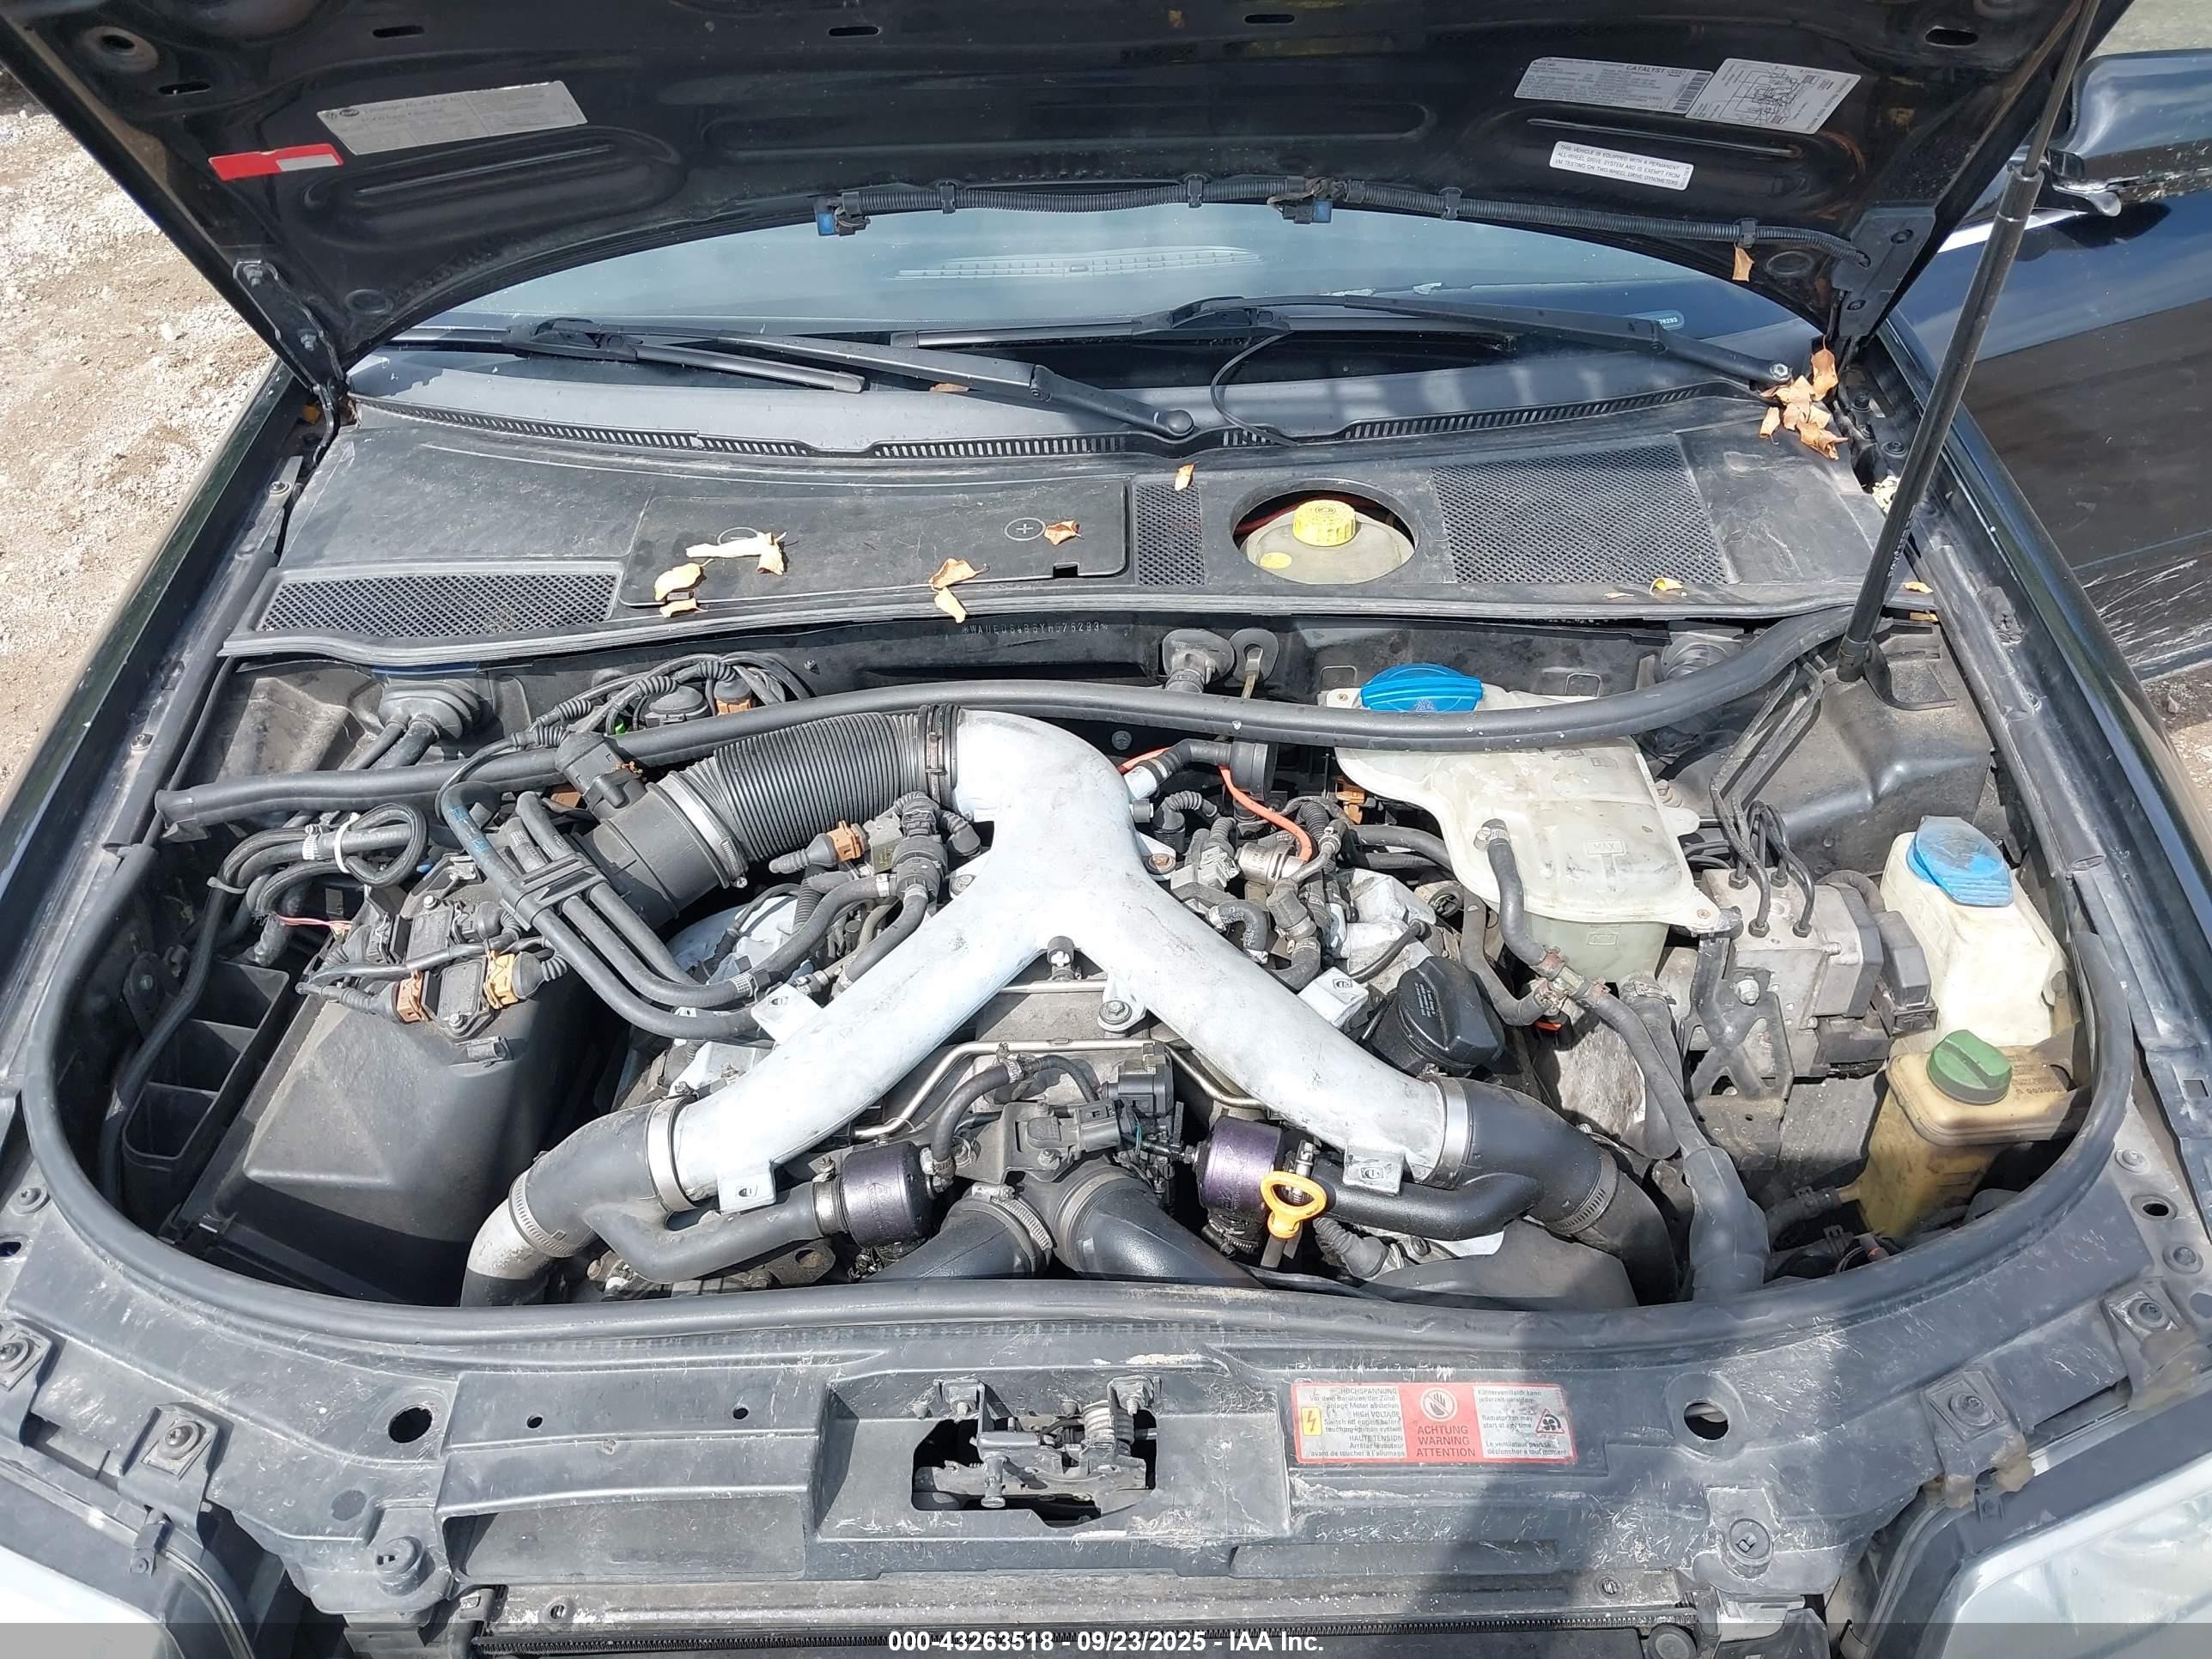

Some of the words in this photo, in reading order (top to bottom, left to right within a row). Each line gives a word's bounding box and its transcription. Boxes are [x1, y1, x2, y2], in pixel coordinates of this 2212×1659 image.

[1626, 65, 1665, 74] CATALYST
[1558, 152, 1584, 161] ALL-WHEEL
[1644, 167, 1664, 175] EXEMPT
[1574, 147, 1594, 155] VEHICLE
[1602, 151, 1628, 161] EQUIPPED
[1649, 161, 1680, 170] PERMANENT
[1597, 167, 1626, 177] TWO-WHEEL
[1593, 842, 1615, 852] MAX
[1417, 1425, 1469, 1435] ACHTUNG
[1417, 1436, 1470, 1445] WARNING
[1416, 1448, 1476, 1457] ATTENTION
